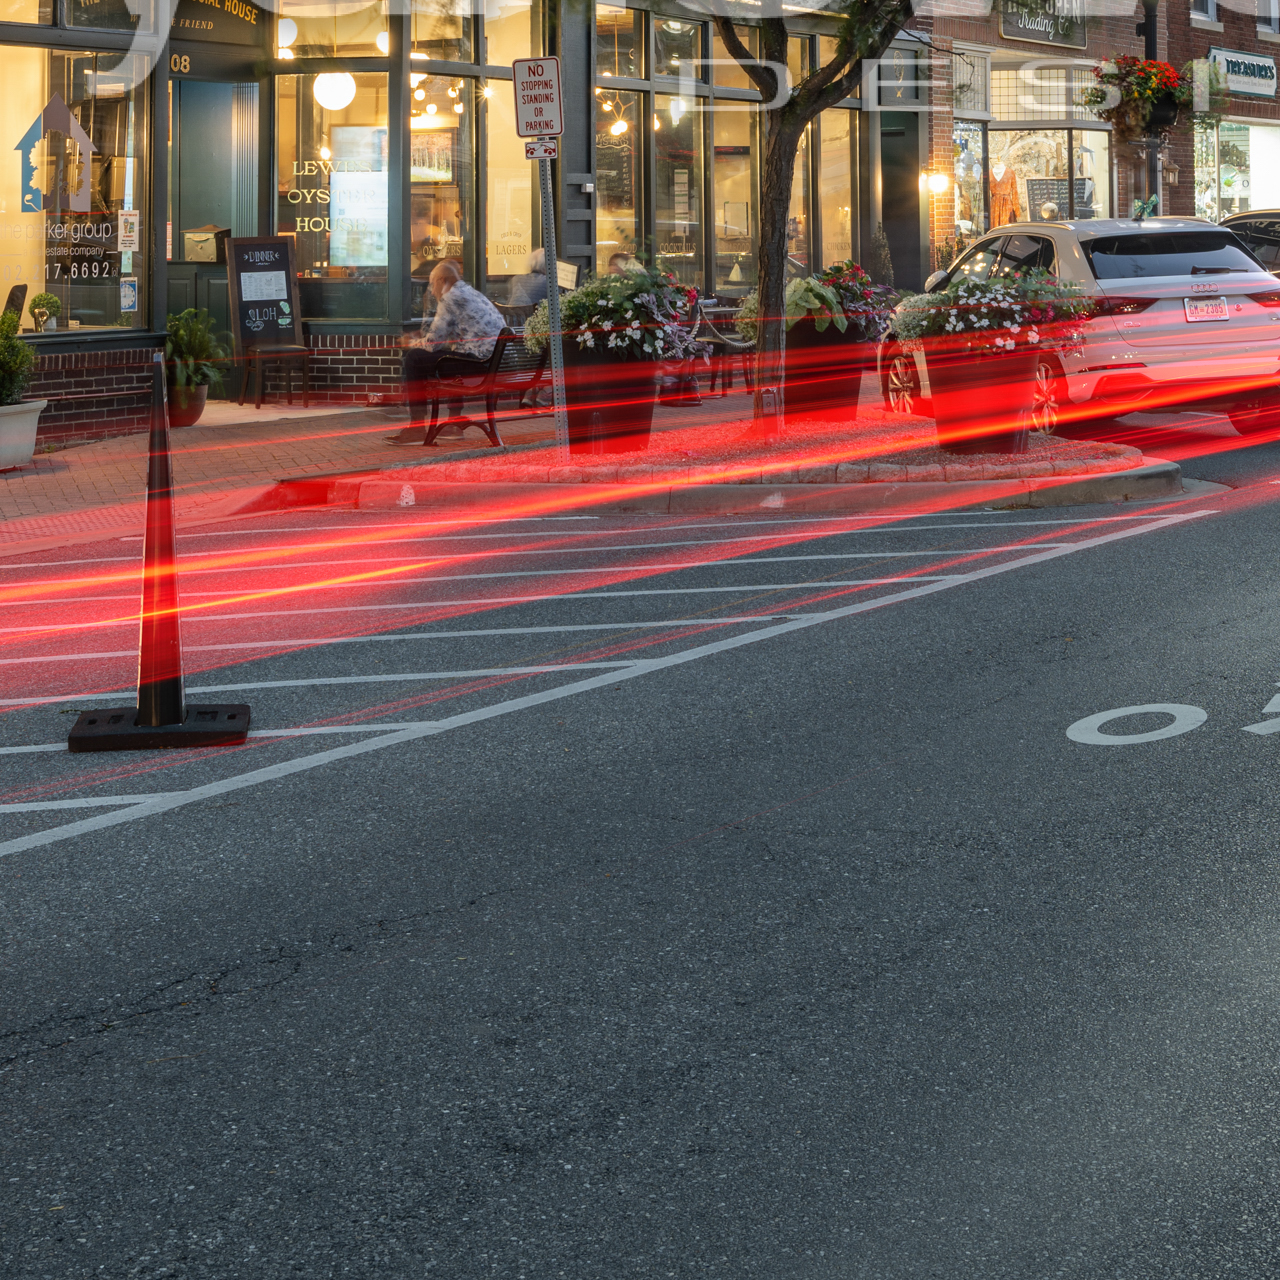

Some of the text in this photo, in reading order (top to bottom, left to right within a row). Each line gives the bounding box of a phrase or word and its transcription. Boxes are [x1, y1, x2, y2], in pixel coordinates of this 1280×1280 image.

[179, 18, 214, 30] FRIEND
[1019, 9, 1055, 40] Trading
[528, 64, 544, 77] NO
[1225, 57, 1275, 80] TREASURES
[521, 79, 553, 91] STOPPING
[522, 92, 554, 105] STANDING
[534, 107, 544, 117] OR
[525, 119, 554, 131] PARKING
[292, 160, 372, 176] LEWES
[287, 189, 376, 204] OYSTER
[295, 217, 368, 232] HOUSE
[0, 220, 112, 243] the parker group
[46, 246, 69, 256] estate
[70, 246, 104, 257] company
[496, 245, 527, 255] LAGERS
[659, 242, 697, 253] COCKTAILS
[248, 250, 275, 262] DINNER
